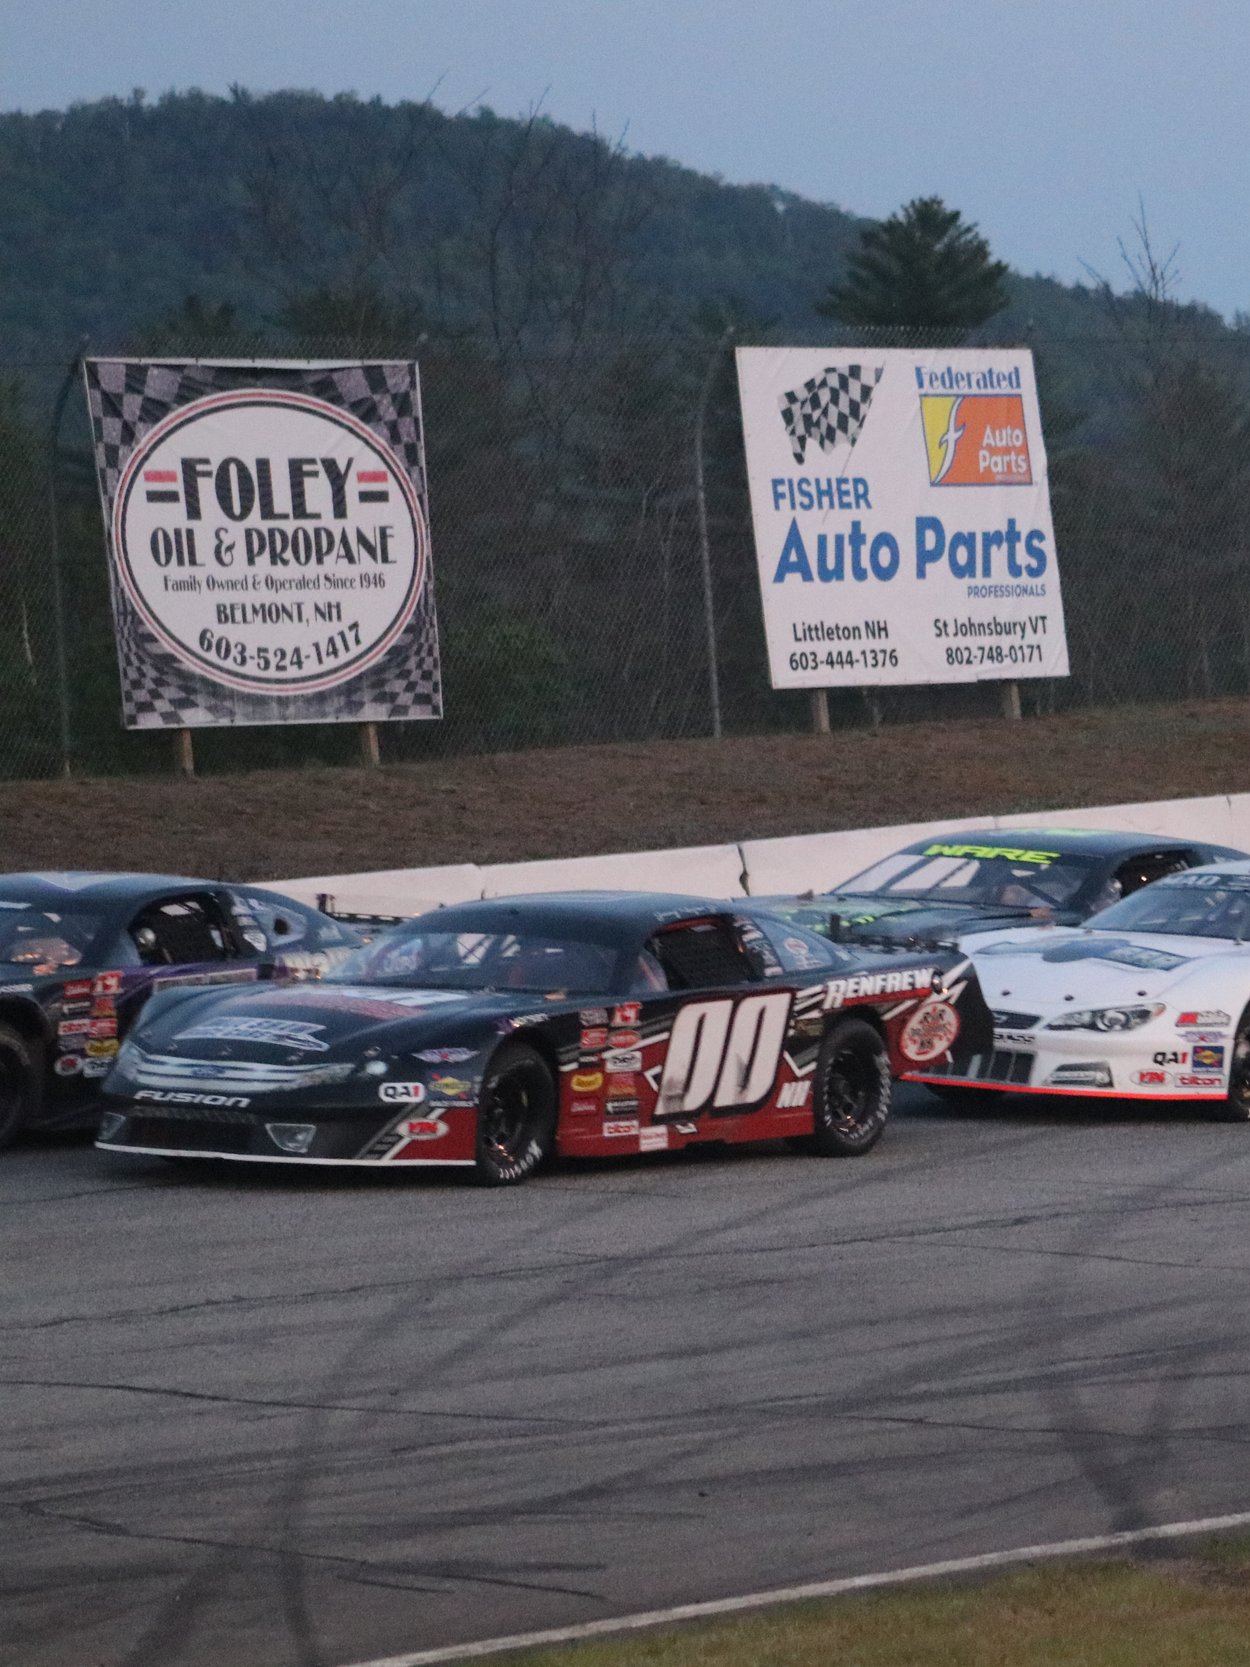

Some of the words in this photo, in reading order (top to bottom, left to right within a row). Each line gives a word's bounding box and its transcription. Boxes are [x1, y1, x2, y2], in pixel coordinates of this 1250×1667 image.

[915, 366, 1021, 389] Federated
[982, 425, 1023, 447] Auto
[979, 450, 1027, 474] Parts
[181, 456, 354, 521] FOLEY
[771, 477, 872, 511] FISHER
[150, 527, 206, 568] OIL
[213, 526, 236, 567] &
[244, 526, 397, 567] PROPANE
[773, 516, 900, 584] Auto
[915, 516, 1047, 580] Parts
[164, 574, 202, 593] Family
[206, 573, 248, 592] Owned
[252, 573, 262, 591] &
[265, 573, 320, 593] Operated
[323, 572, 356, 591] Since
[359, 572, 386, 589] 1946
[967, 584, 1046, 598] PROFESSIONALS
[216, 602, 309, 626] BELMONT,
[314, 601, 342, 623] NH
[793, 620, 861, 643] Littleton
[865, 620, 889, 640] NH
[934, 618, 950, 638] St
[953, 616, 1026, 640] Johnsbury
[1029, 616, 1048, 635] VT
[198, 621, 364, 672] 603-524-1417
[945, 644, 1043, 666] 802-748-0171
[789, 649, 898, 671] 603-444-1376
[923, 844, 1061, 865] WARE
[822, 968, 934, 1010] RENFREW
[654, 992, 793, 1118] 00
[1153, 1051, 1188, 1066] QA1
[133, 1090, 251, 1108] FUSION
[384, 1085, 421, 1099] QA1
